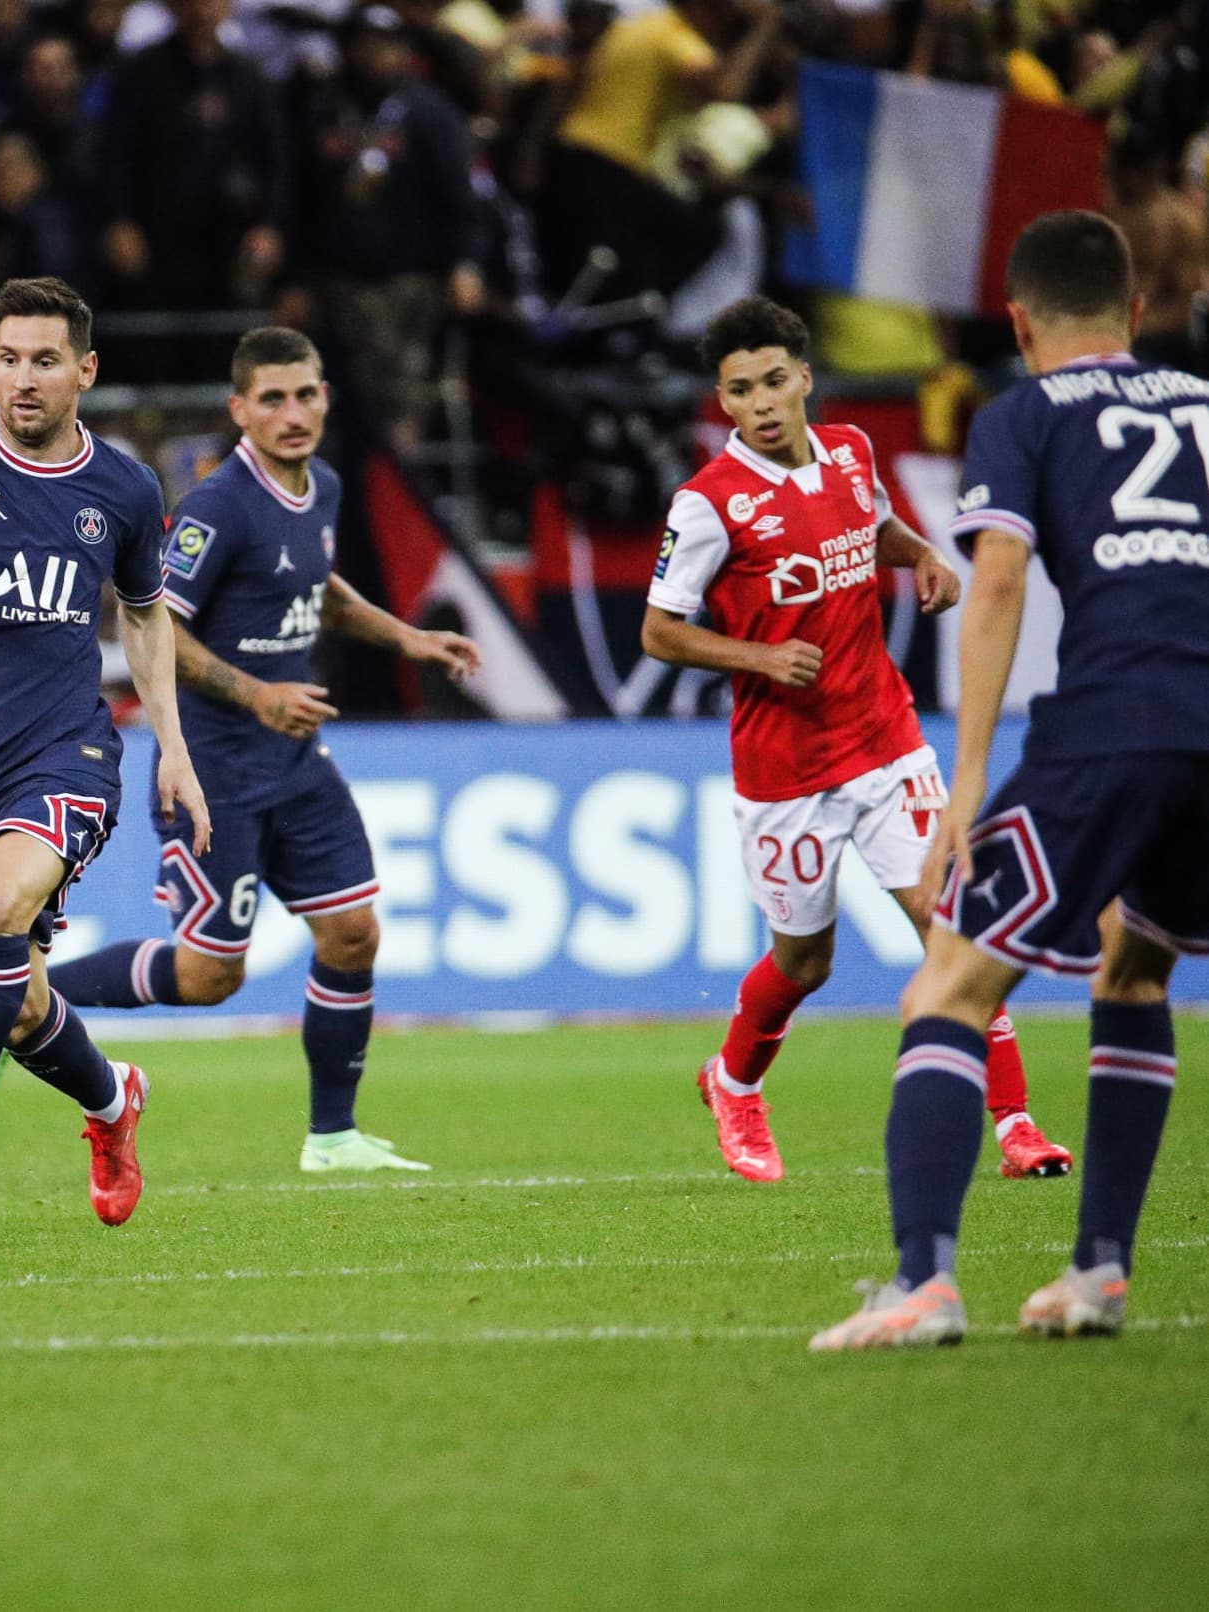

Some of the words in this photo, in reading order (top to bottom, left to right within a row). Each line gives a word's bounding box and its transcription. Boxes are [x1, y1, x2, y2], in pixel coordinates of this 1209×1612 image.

[1, 605, 36, 622] LIVE
[758, 833, 824, 886] 20
[229, 872, 259, 927] 6
